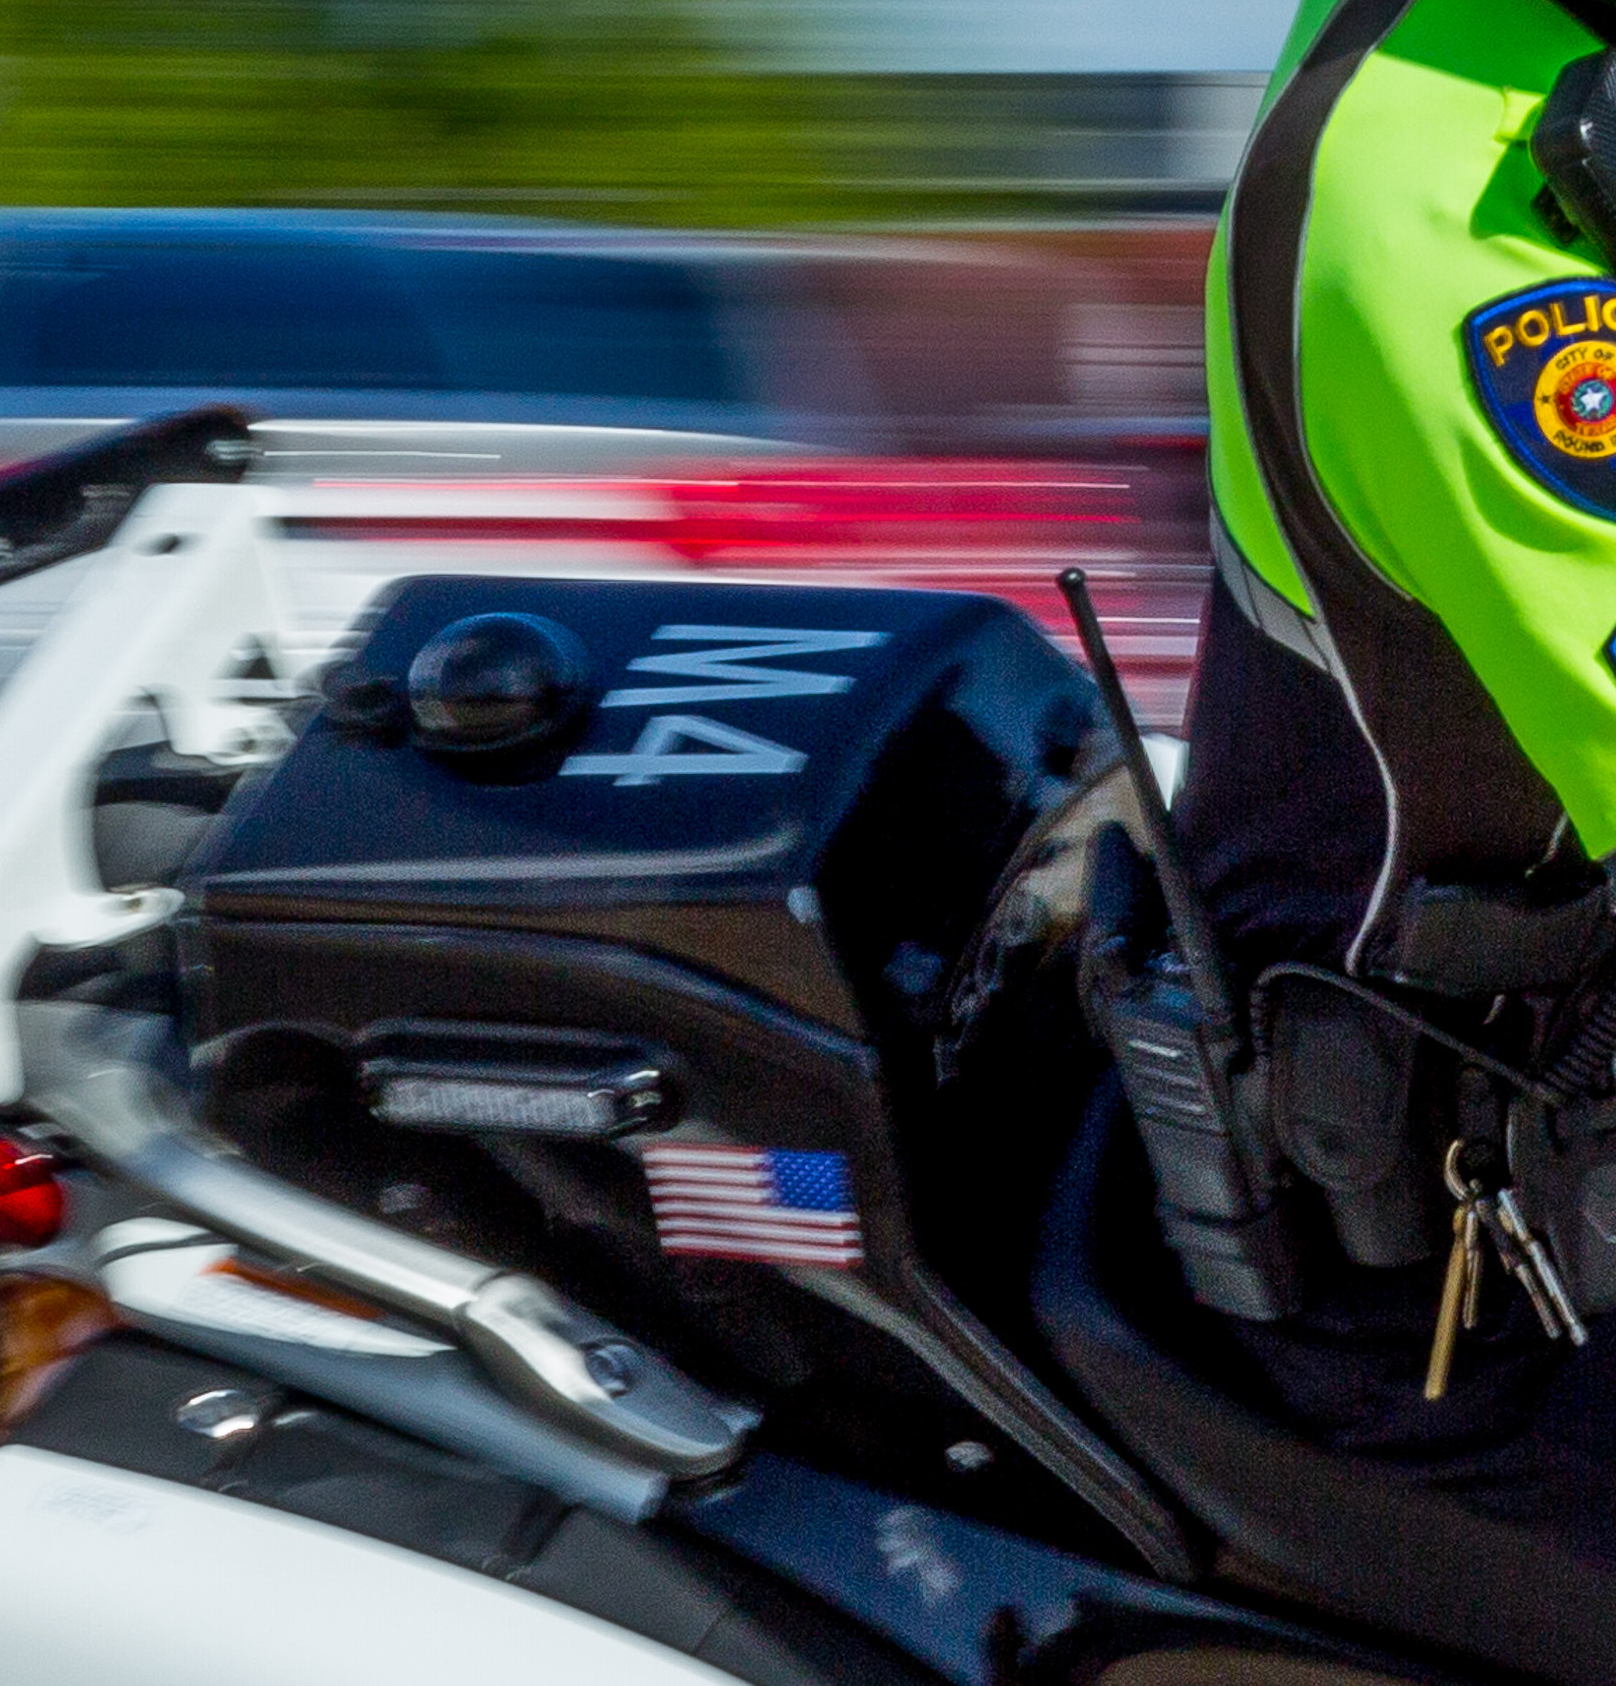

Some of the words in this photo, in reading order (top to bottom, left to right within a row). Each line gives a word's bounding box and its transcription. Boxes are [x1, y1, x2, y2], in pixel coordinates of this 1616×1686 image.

[1555, 347, 1588, 370] CITY
[1593, 348, 1615, 361] OF
[1552, 430, 1605, 453] ROUND
[559, 623, 893, 788] M4
